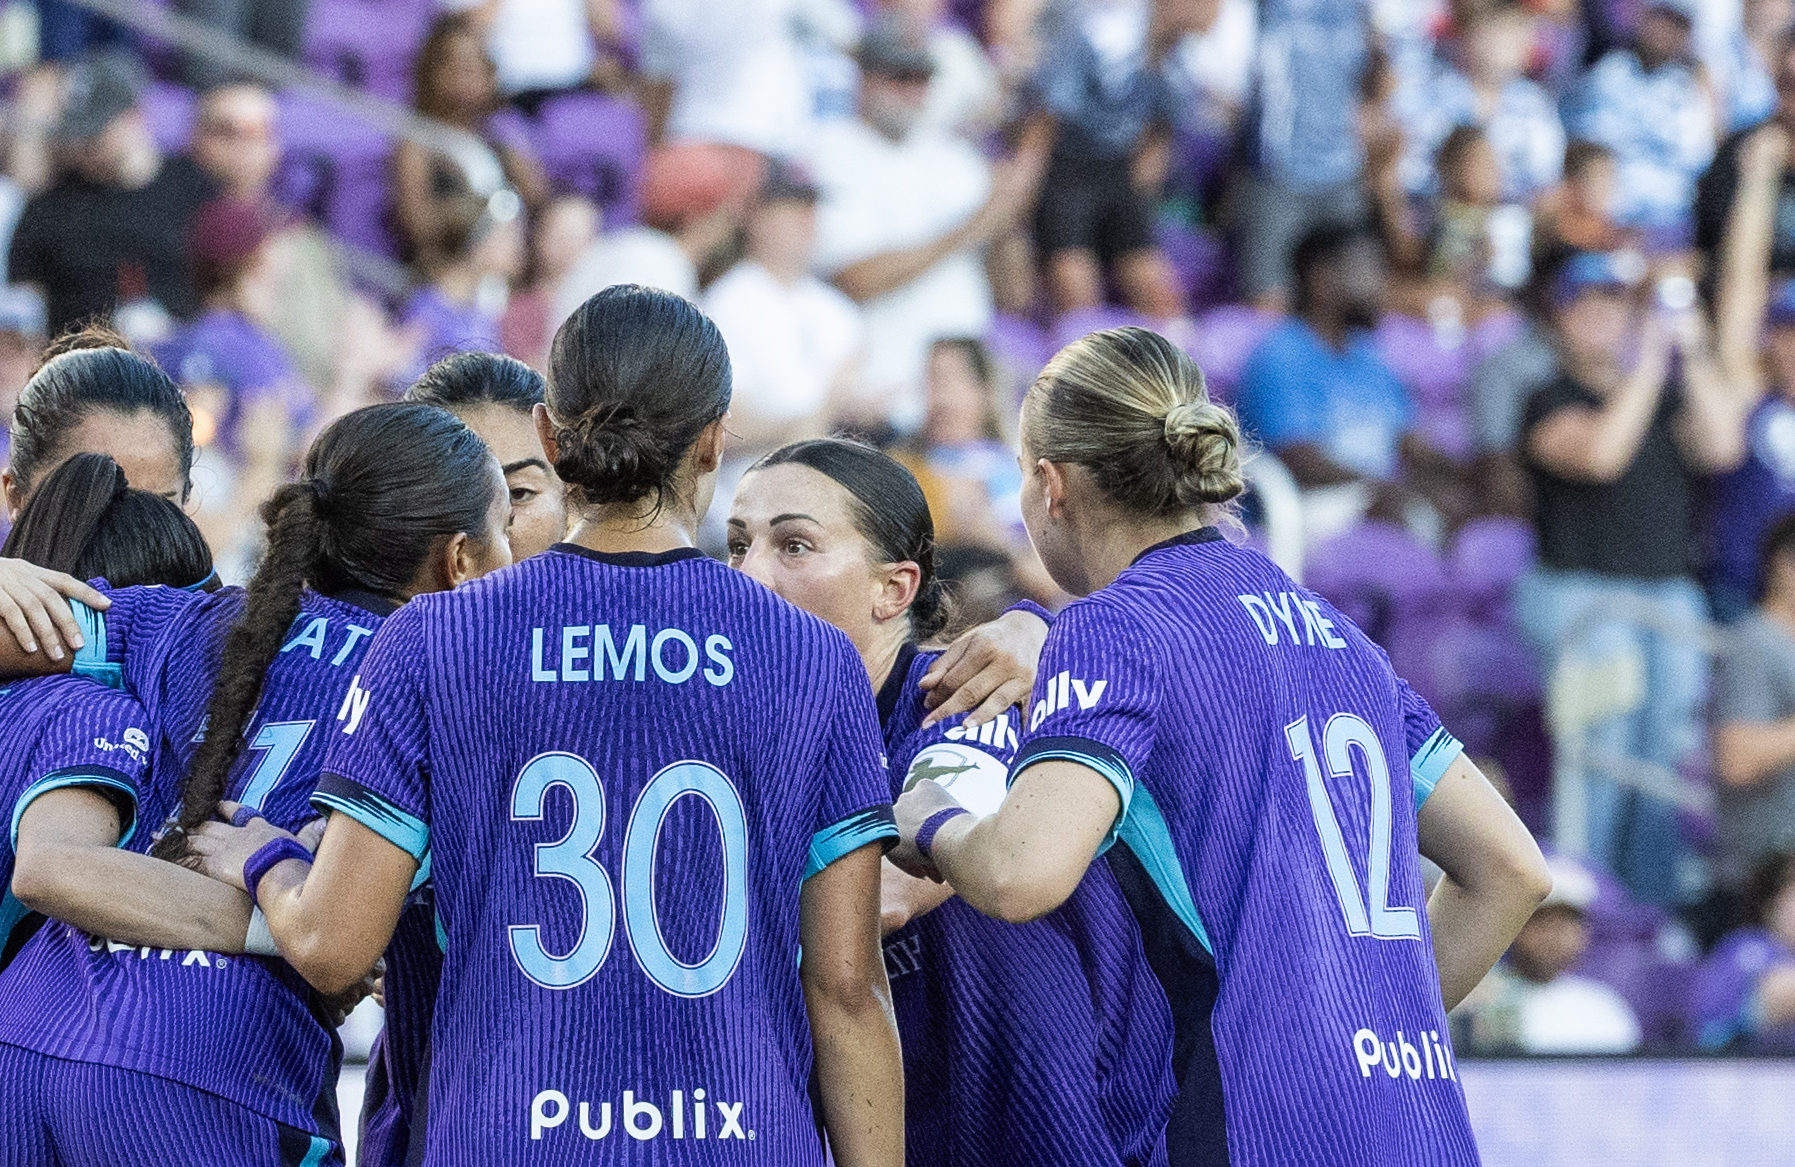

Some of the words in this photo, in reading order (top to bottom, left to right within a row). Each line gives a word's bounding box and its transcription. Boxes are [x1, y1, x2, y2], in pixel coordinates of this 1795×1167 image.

[280, 613, 374, 667] AT
[531, 624, 735, 687] LEMOS
[336, 675, 371, 735] ly
[1284, 713, 1422, 942] 12
[508, 751, 749, 999] 30
